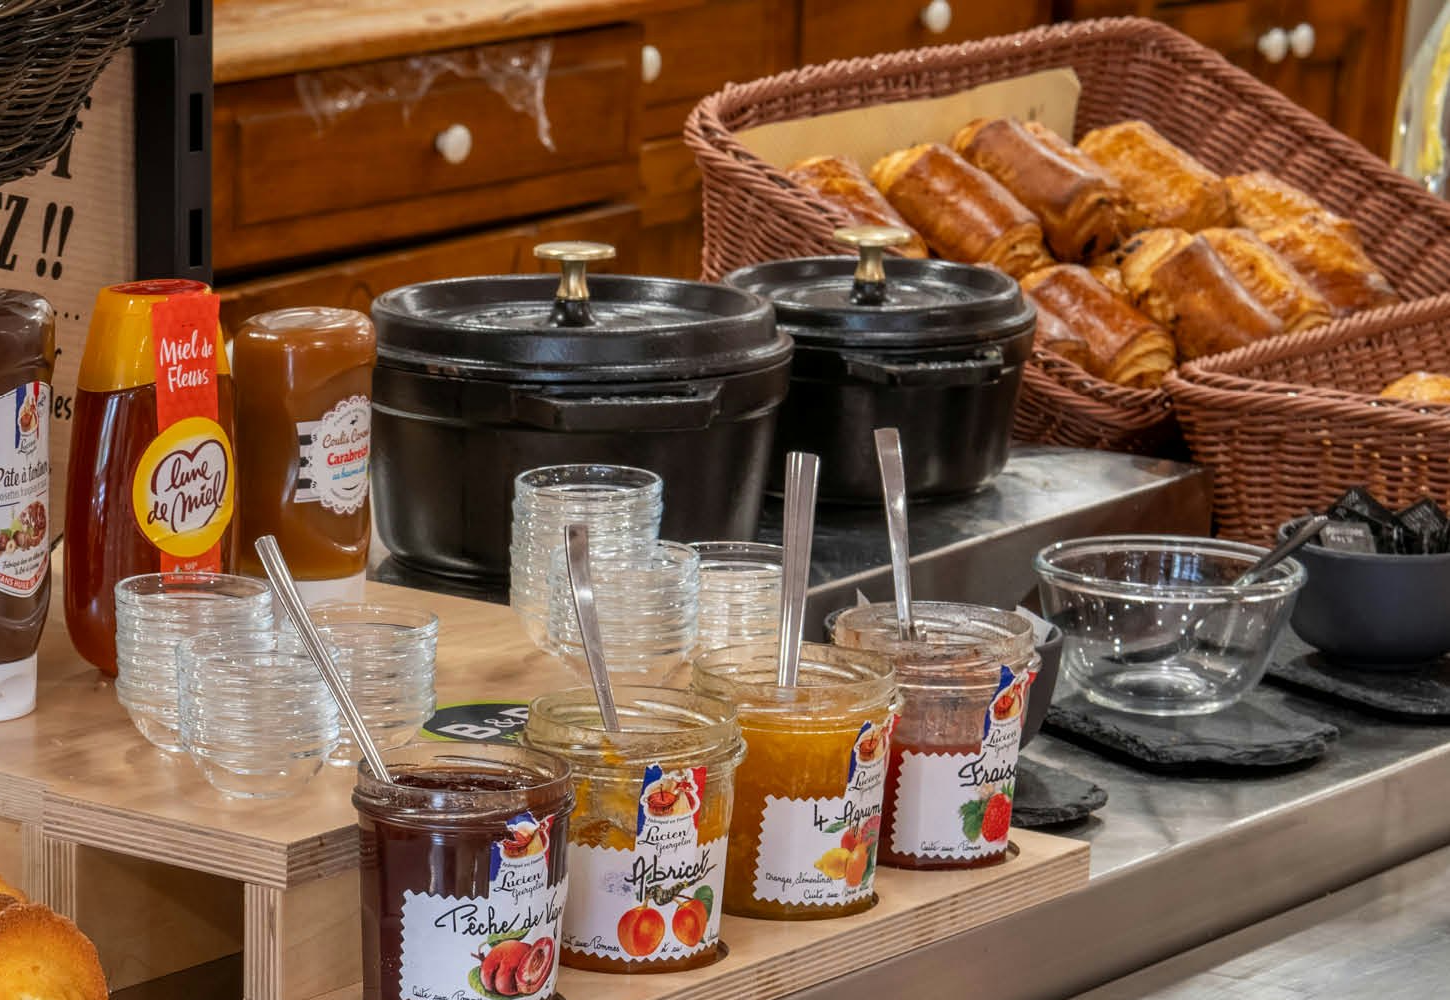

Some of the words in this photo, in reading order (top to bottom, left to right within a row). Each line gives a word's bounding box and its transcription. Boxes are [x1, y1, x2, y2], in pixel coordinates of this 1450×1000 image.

[158, 328, 199, 367] Miel
[201, 336, 214, 358] de
[167, 363, 210, 393] Fleurs
[146, 500, 169, 526] de
[984, 728, 1017, 749] Lucien
[814, 804, 829, 831] 4
[637, 825, 689, 846] Lucien
[493, 870, 544, 892] Lucien
[624, 849, 712, 903] Abricot
[434, 903, 520, 936] Pêche
[520, 904, 543, 931] de
